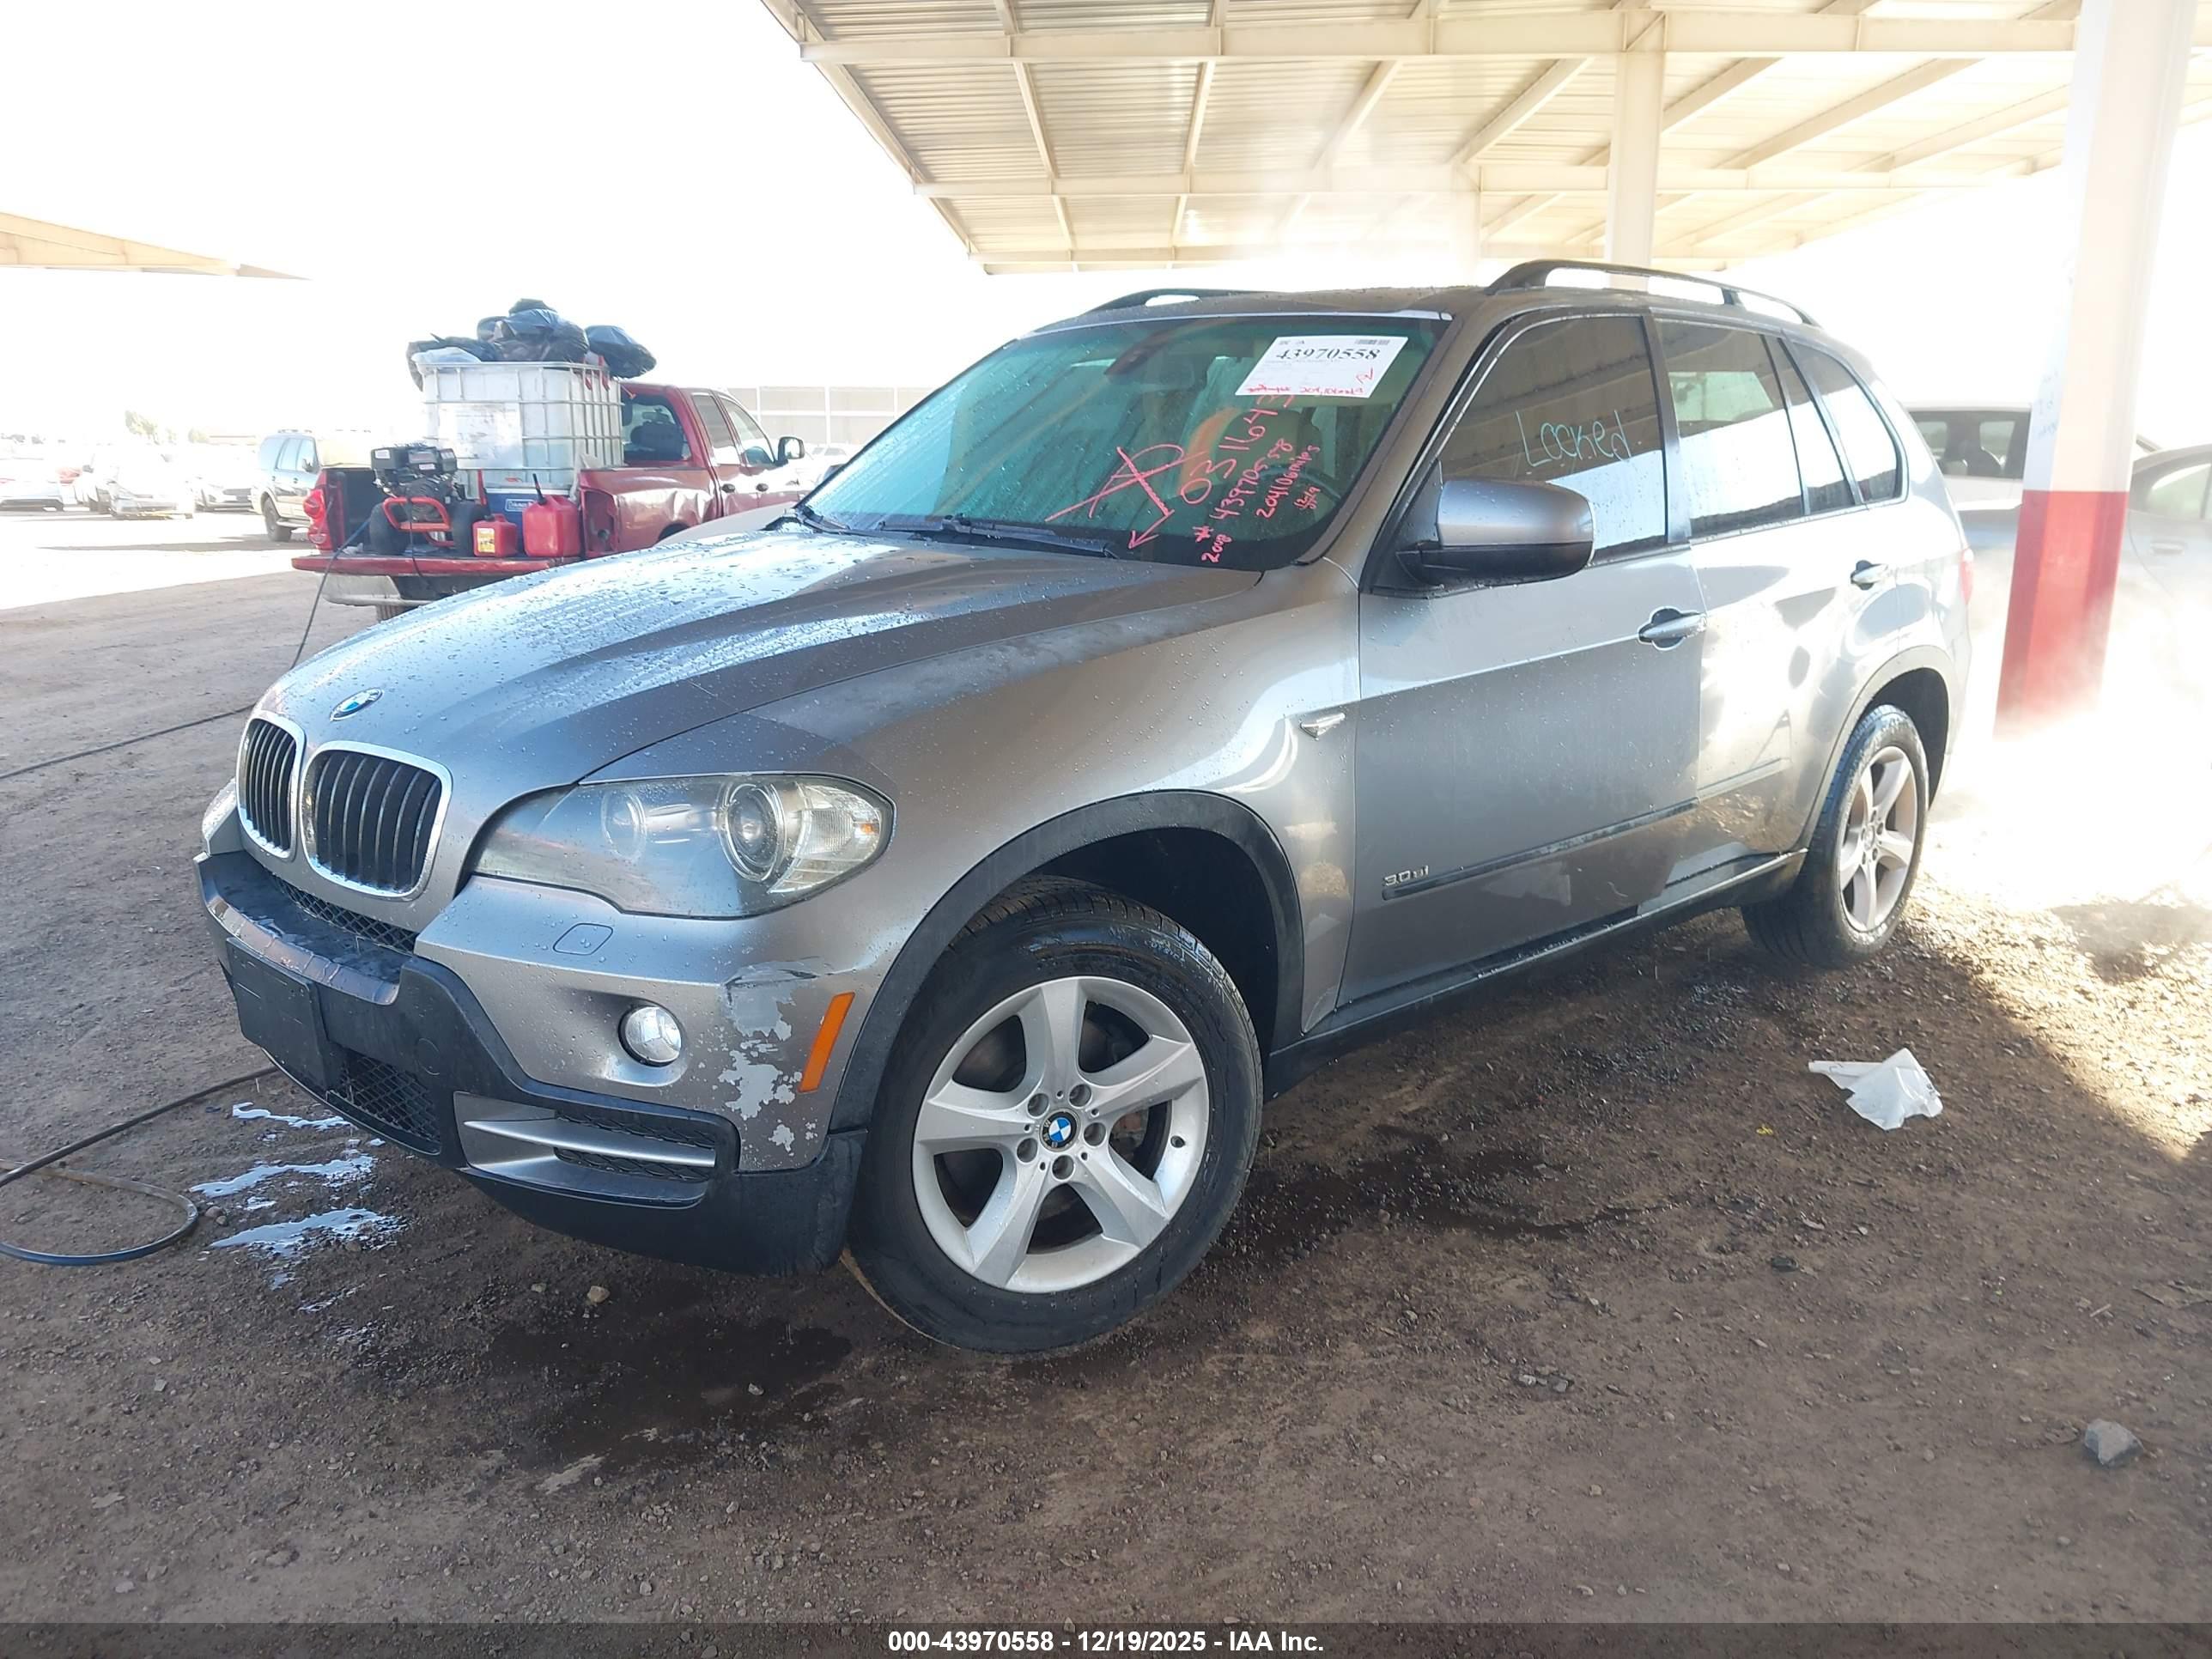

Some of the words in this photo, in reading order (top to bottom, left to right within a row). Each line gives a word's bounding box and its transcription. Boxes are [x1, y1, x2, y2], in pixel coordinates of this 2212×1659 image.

[1276, 347, 1381, 360] 43970558
[1515, 409, 1632, 467] Locked
[1209, 438, 1293, 520] 43970558
